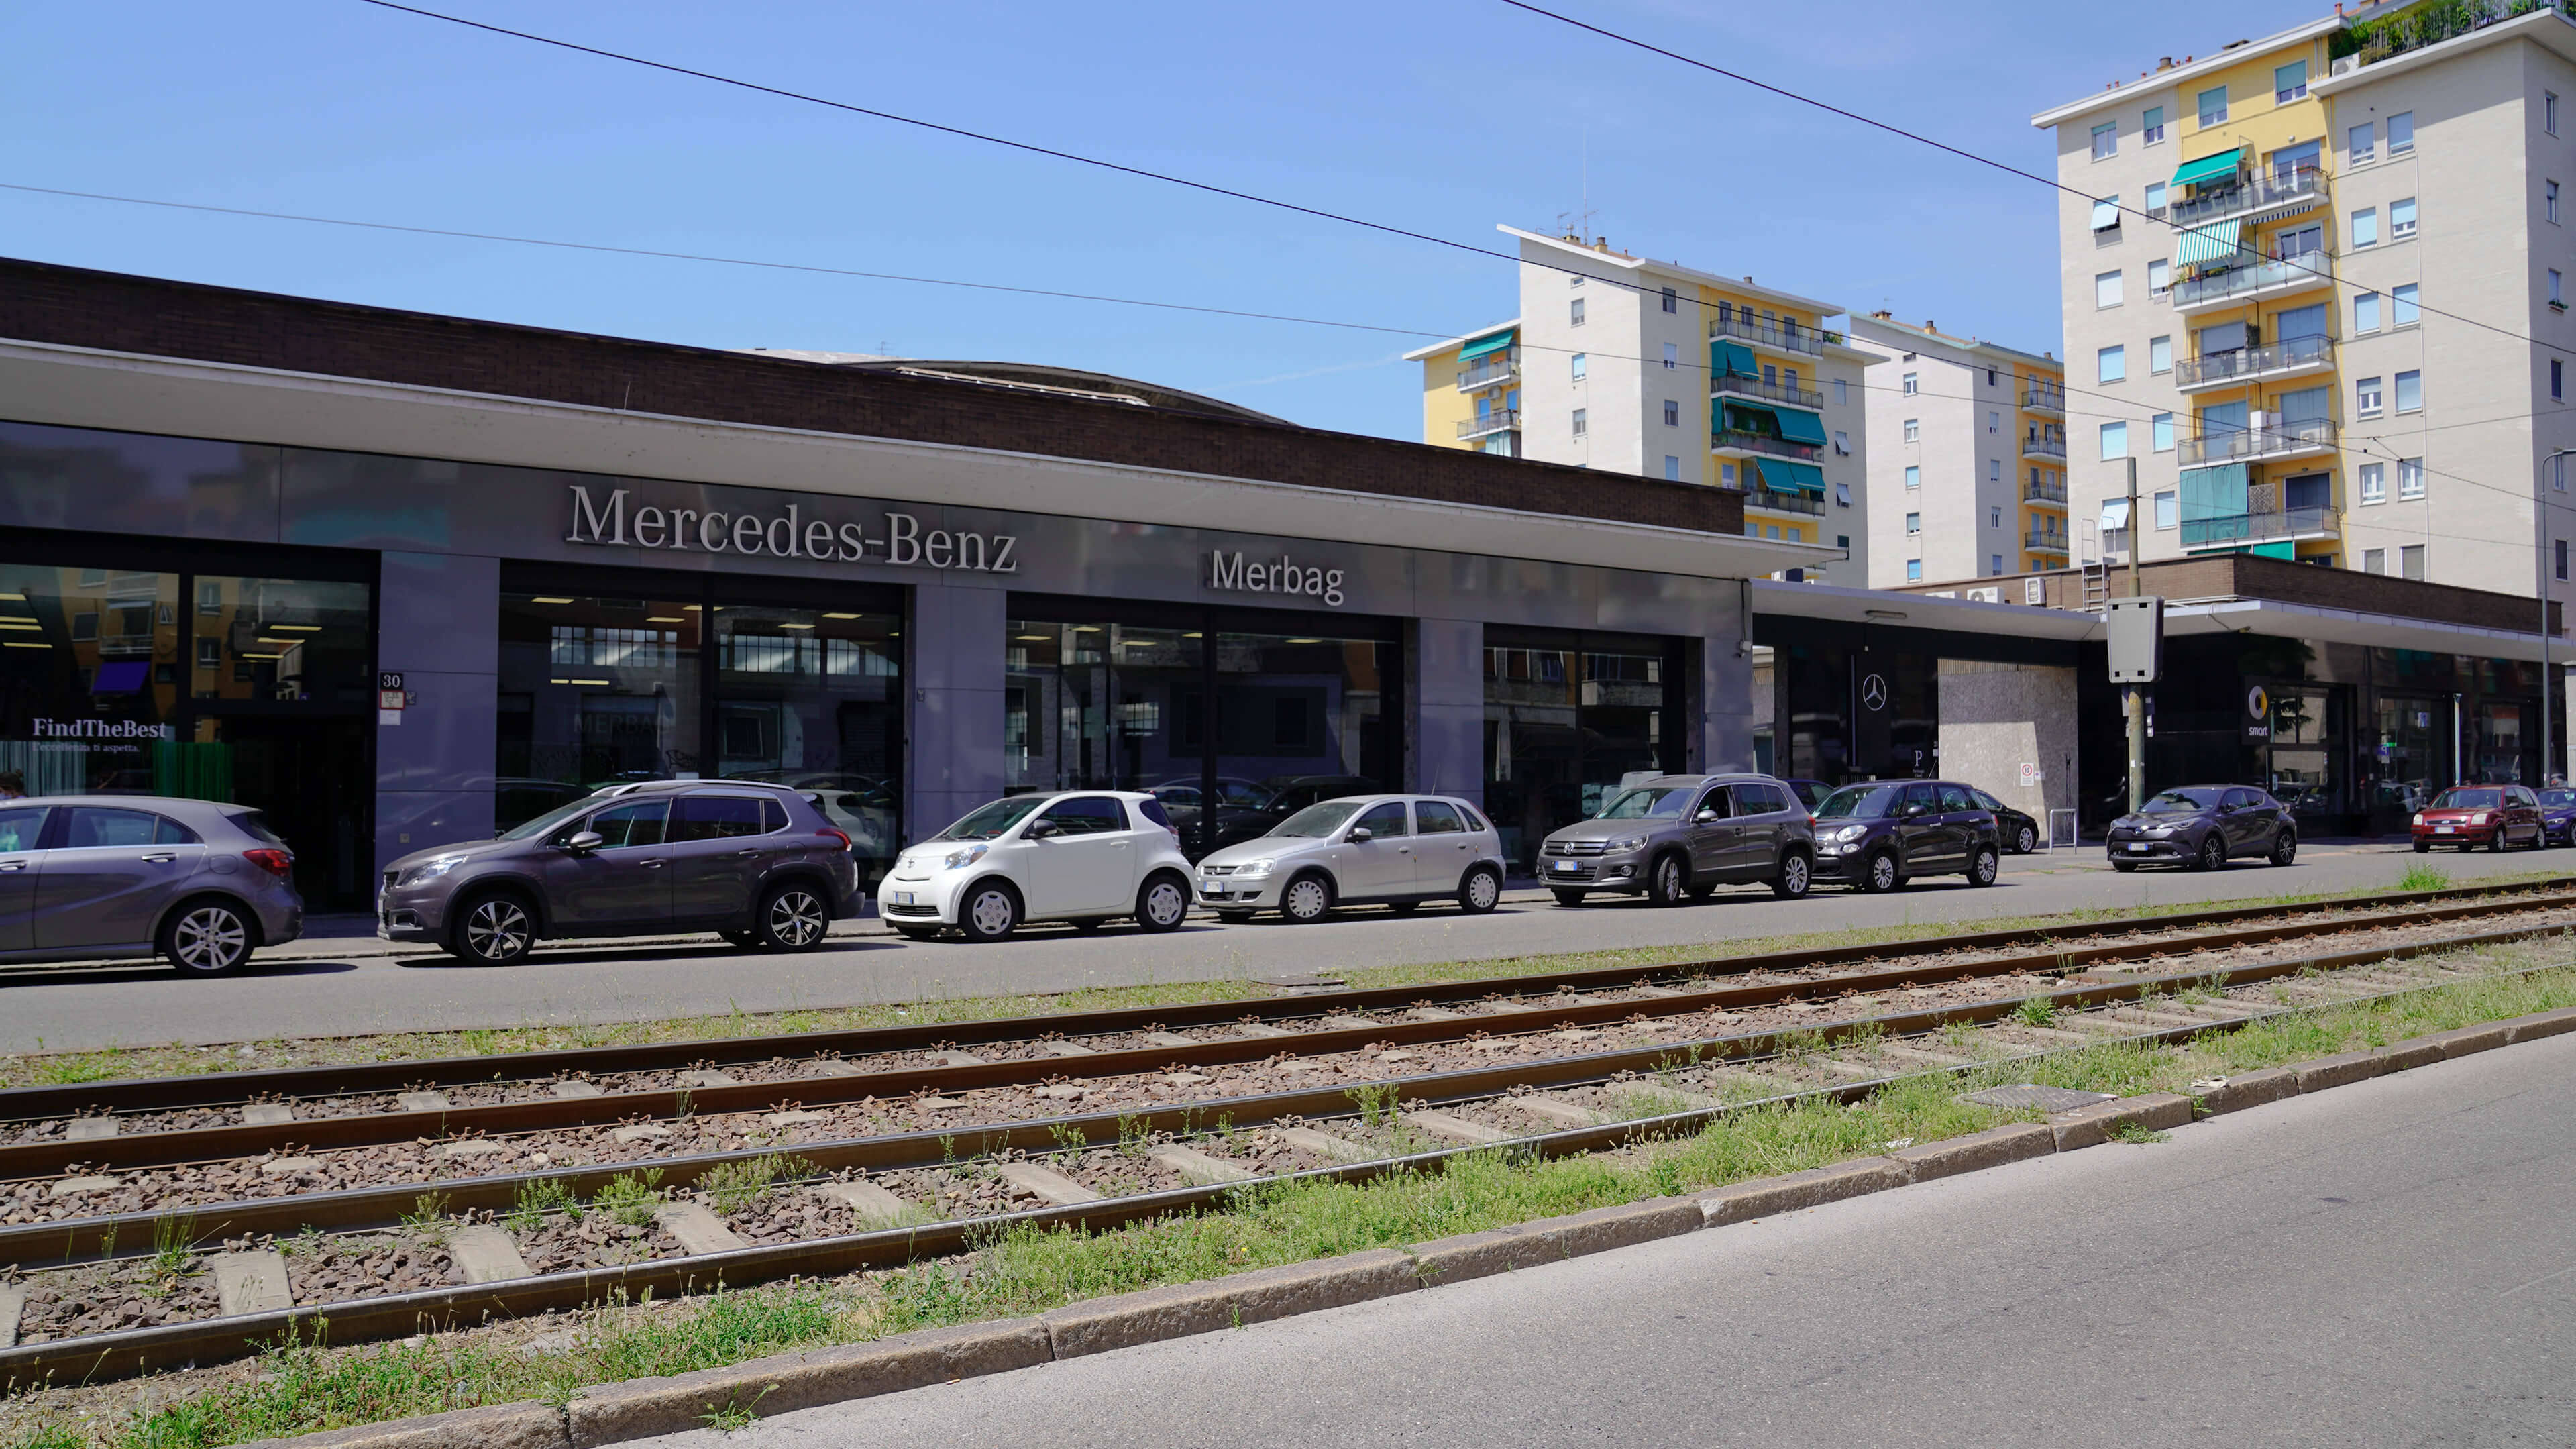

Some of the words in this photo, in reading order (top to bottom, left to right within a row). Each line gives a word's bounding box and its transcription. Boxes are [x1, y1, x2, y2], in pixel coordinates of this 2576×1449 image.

[566, 485, 1018, 572] Mercedes-Benz
[1212, 549, 1344, 606] Merbag
[383, 674, 400, 688] 30
[33, 718, 167, 738] FindTheBest
[2249, 725, 2267, 737] smart
[1915, 750, 1923, 767] P
